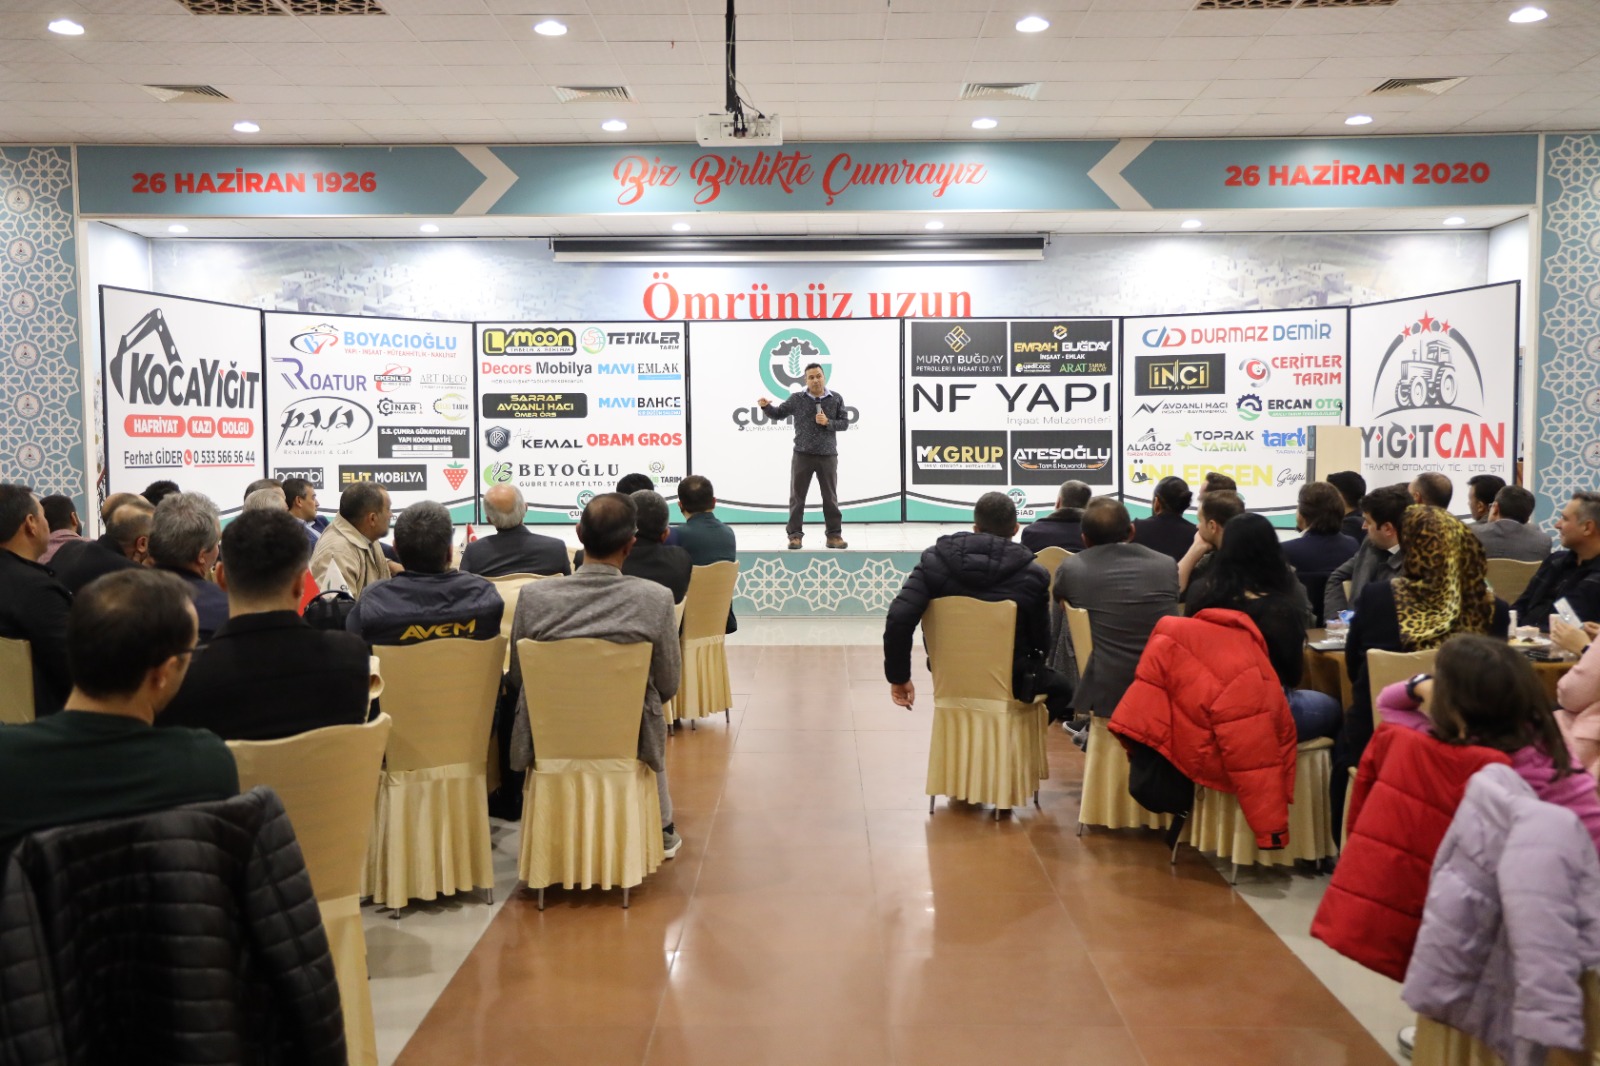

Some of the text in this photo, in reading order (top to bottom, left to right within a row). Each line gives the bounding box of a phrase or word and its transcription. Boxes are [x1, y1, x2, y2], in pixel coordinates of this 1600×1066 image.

[132, 168, 377, 193] 26 HAZİRAN 1926
[613, 151, 988, 206] Biz Birlikte Çumrayız
[1224, 160, 1490, 187] 26 HAZİRAN 2020
[643, 272, 972, 320] Ömrünüz uzun
[1191, 319, 1332, 344] DURMAZ DEMİR
[344, 331, 457, 350] BOYACIOĞLU
[1014, 340, 1111, 353] EMRAH BUĞDAY
[916, 353, 1004, 364] MURAT BUĞDAY
[1271, 353, 1342, 369] CERİTLER
[271, 357, 367, 391] ROATUR
[481, 362, 592, 377] Decors Mobilya
[638, 363, 679, 374] EMLAK
[1059, 363, 1087, 373] ARAT
[1153, 365, 1205, 386] İNCİ
[129, 352, 259, 409] KOCAYİĞİT
[442, 374, 468, 384] DECO
[1293, 372, 1341, 386] TARIM
[510, 394, 562, 402] SARRAF
[913, 382, 1111, 413] NF YAPI
[1267, 398, 1343, 409] ERCAN OTO
[497, 403, 574, 411] AVDANLI HACI
[134, 416, 249, 435] HAFRİYAT KAZI DOLGU
[1006, 415, 1112, 426] İnşaat Malzemeleri
[393, 428, 415, 436] ÇUMRA
[415, 427, 446, 435] GÜNAYDIN
[413, 435, 451, 443] KOOPERATİFİ
[1194, 430, 1254, 441] TOPRAK
[522, 439, 583, 449] KEMAL
[586, 432, 682, 447] OBAM GROS
[1126, 442, 1172, 451] ALAGÖZ
[1202, 442, 1247, 452] TARIM
[124, 448, 255, 465] Ferhat GİDER 0 533 566 56 44
[943, 445, 1004, 463] GRUP
[1012, 445, 1111, 462] ATEŞOĞLU
[518, 459, 619, 477] BEYOĞLU
[1364, 462, 1400, 471] TRAKTÖR
[1402, 461, 1445, 471] OTOMOTİV
[1447, 461, 1463, 472] TİC.
[1468, 463, 1487, 472] LTD.
[275, 468, 323, 483] bambi
[400, 619, 476, 641] AVEM
